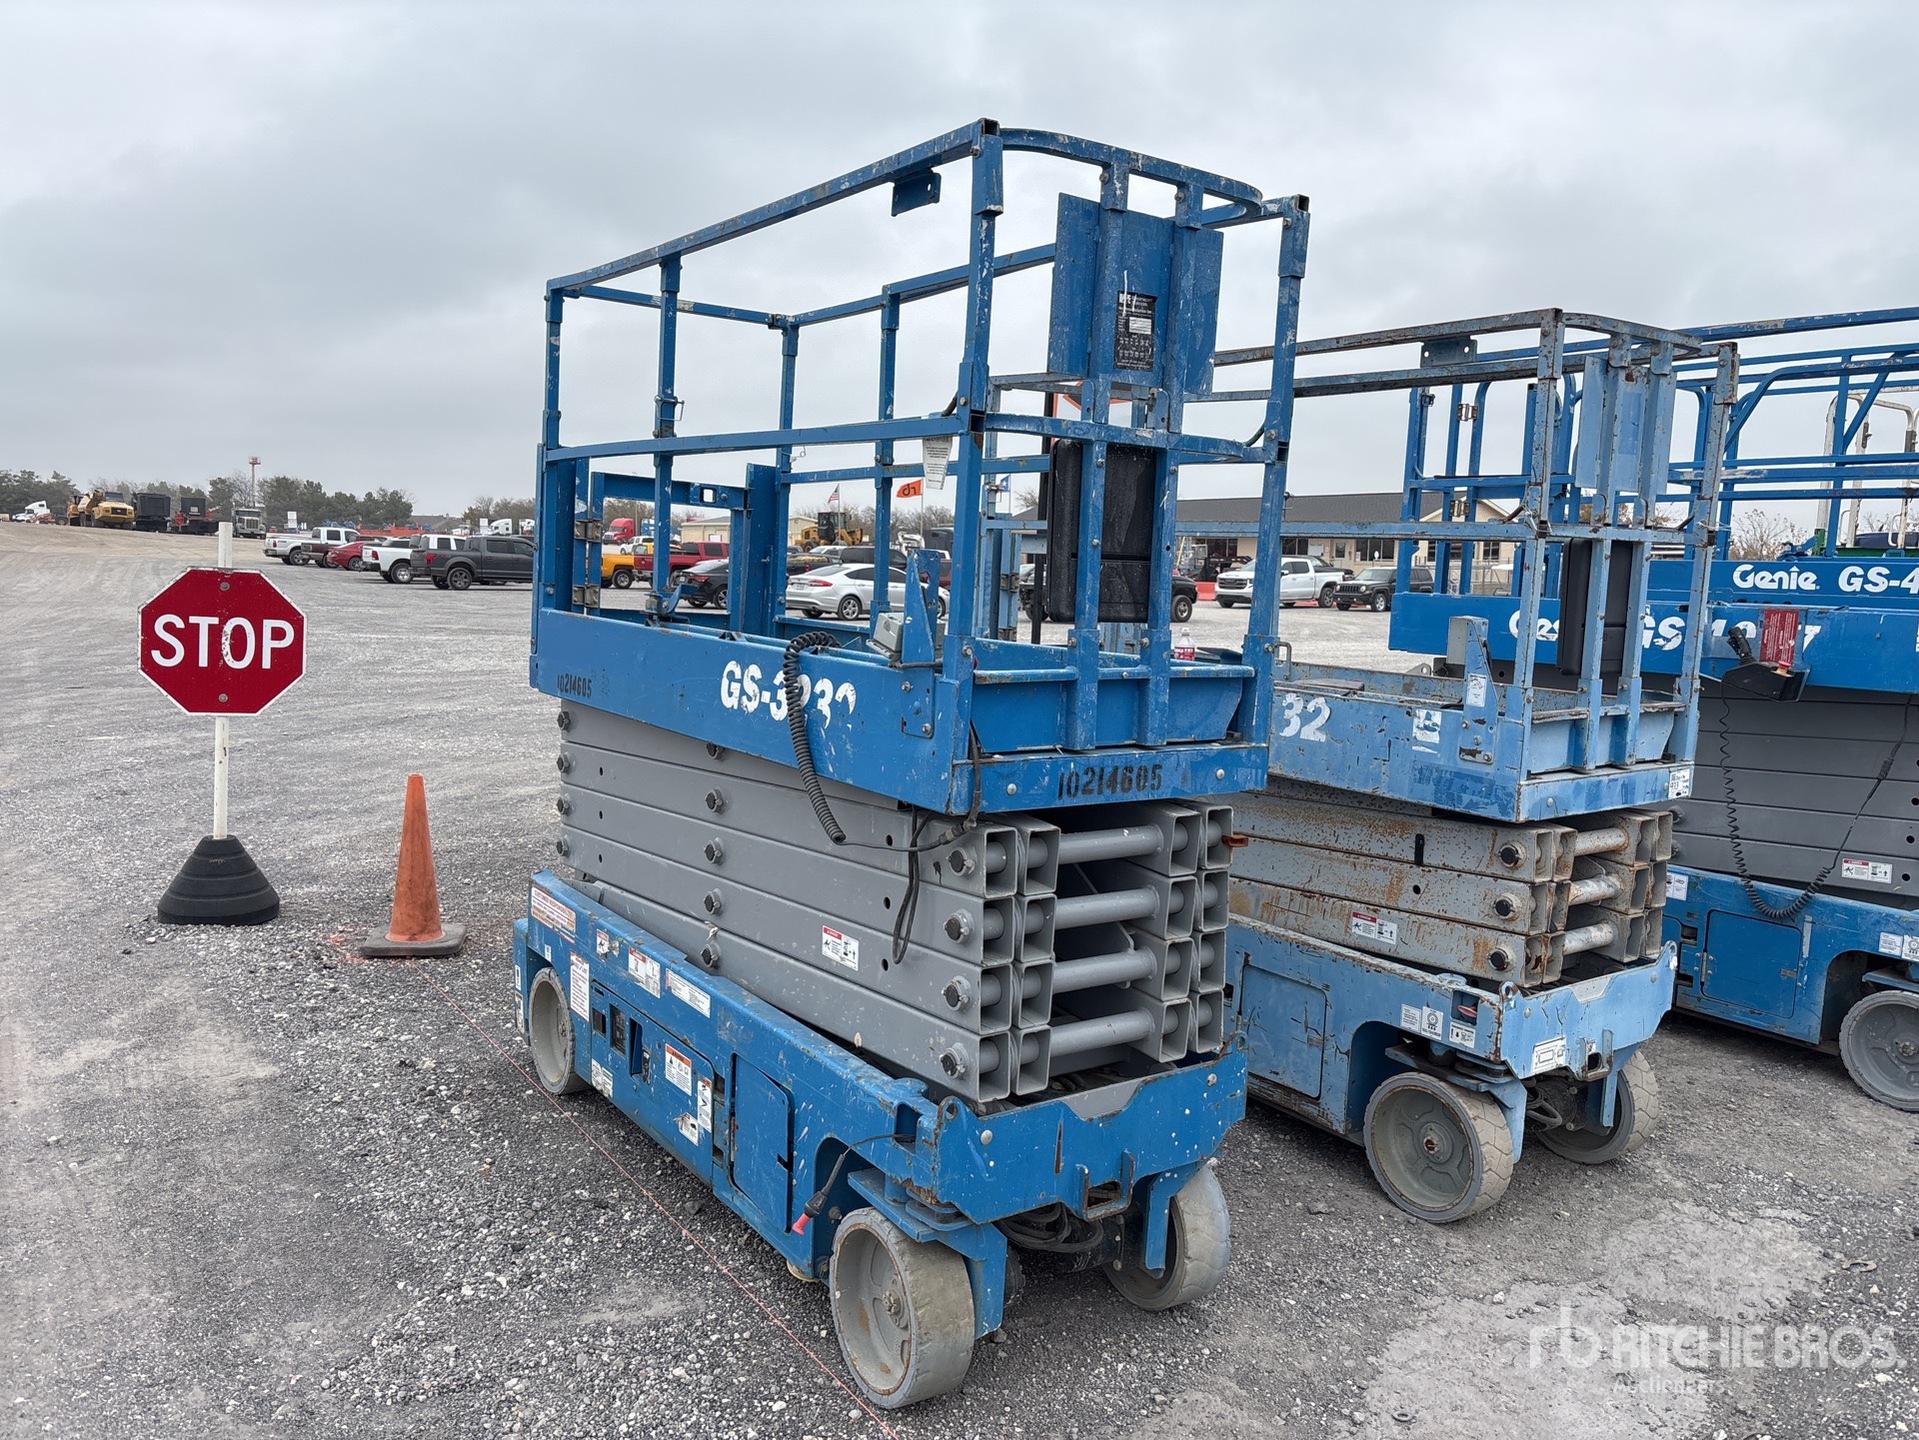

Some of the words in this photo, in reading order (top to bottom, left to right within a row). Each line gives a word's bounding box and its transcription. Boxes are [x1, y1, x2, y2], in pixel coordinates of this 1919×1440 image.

[1732, 563, 1819, 591] Genie
[1838, 565, 1919, 594] GS-4
[151, 613, 295, 669] STOP
[557, 672, 593, 699] 10214605
[1057, 763, 1164, 800] 10214605
